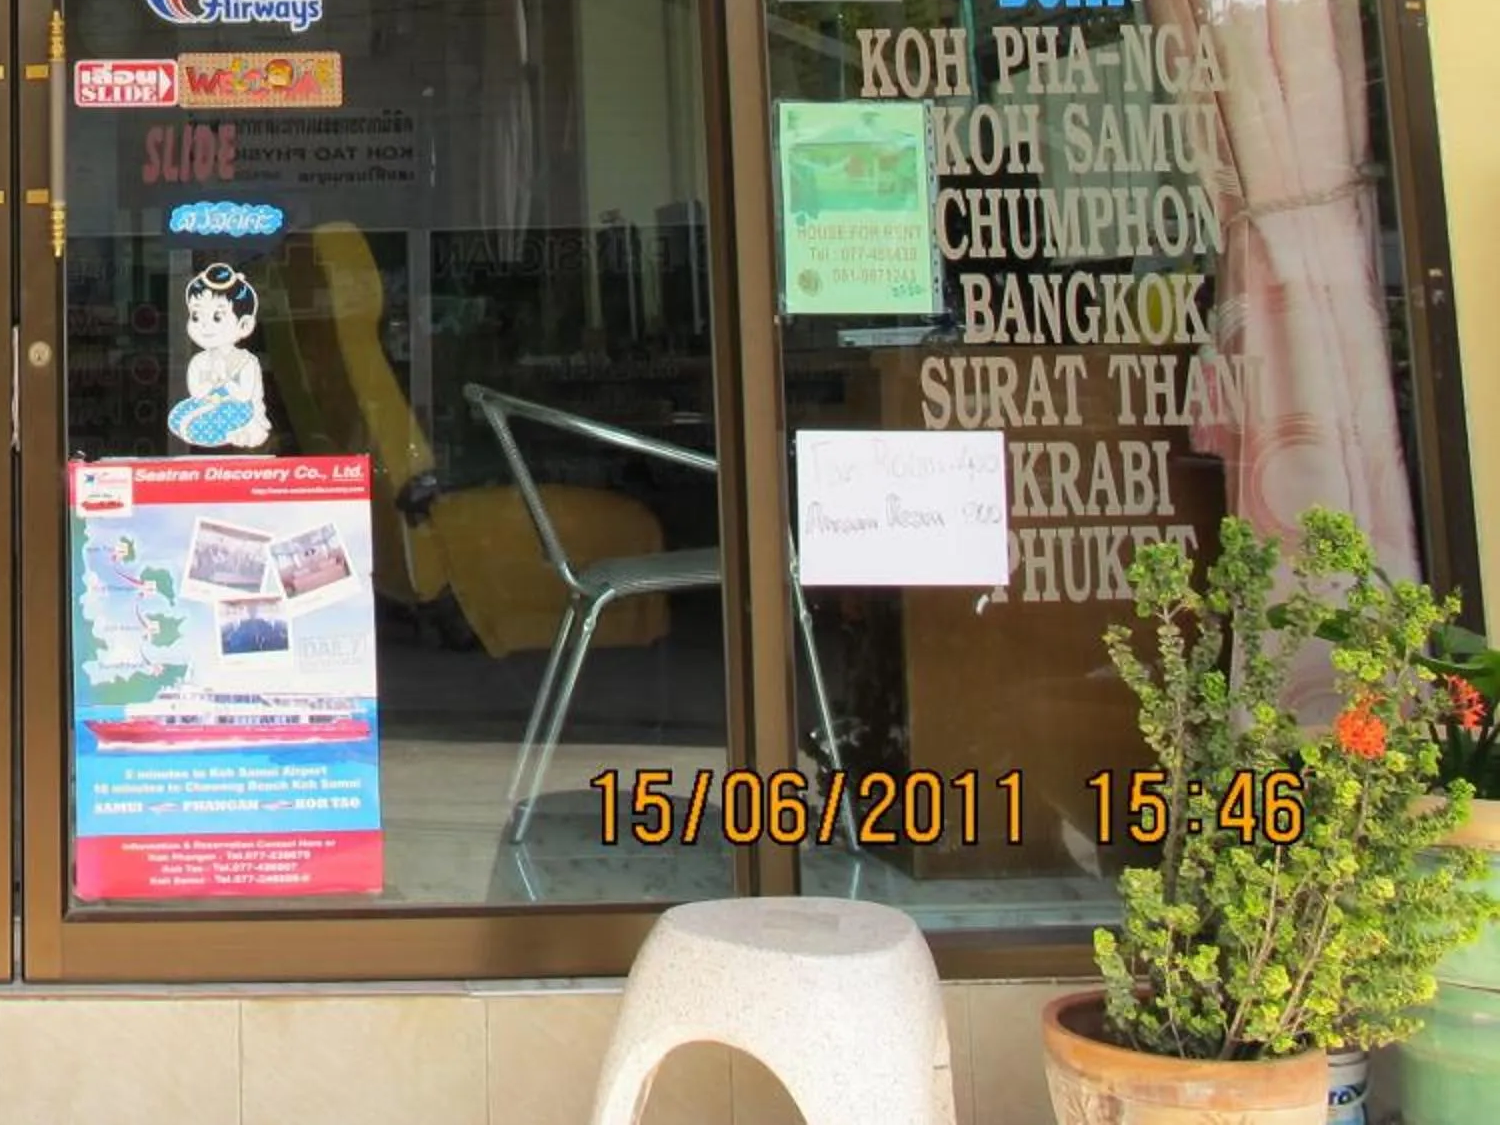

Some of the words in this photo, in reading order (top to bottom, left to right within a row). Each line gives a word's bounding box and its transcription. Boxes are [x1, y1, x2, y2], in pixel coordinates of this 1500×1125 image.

[81, 85, 158, 103] SLIDE
[856, 27, 973, 98] KOH
[142, 123, 239, 184] SLIDE
[931, 105, 1044, 175] KOH
[1064, 103, 1224, 175] SAMUI
[936, 184, 1227, 260] CHUMPHON
[961, 273, 1211, 345] BANGKOK
[920, 355, 1088, 430] SURAT
[1107, 354, 1266, 427] THANI
[135, 468, 201, 483] Seatran
[204, 466, 290, 483] Discovery
[1009, 440, 1176, 518] KRABI
